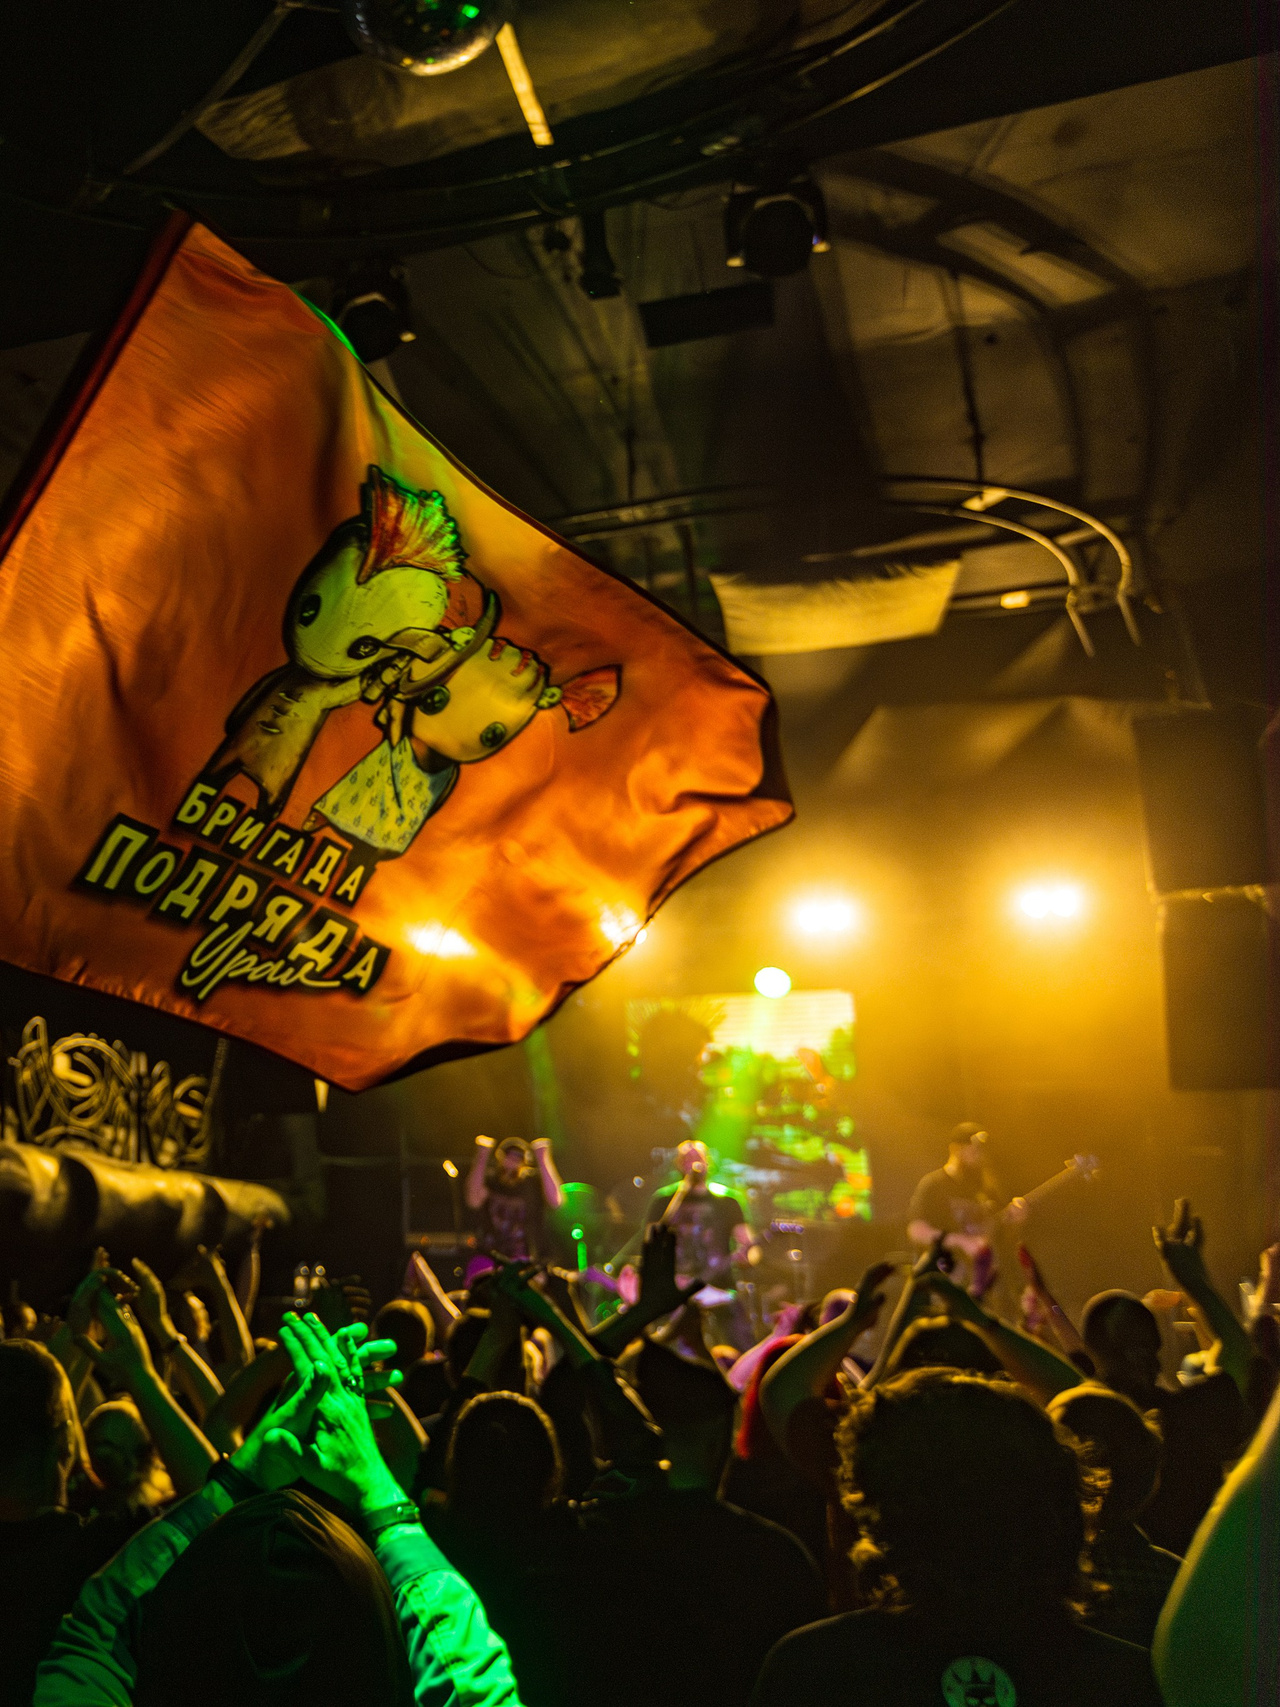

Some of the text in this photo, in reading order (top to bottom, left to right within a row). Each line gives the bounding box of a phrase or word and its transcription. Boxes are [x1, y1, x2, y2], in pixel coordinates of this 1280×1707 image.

[176, 783, 365, 902] БРИГАДА
[85, 823, 378, 989] ПОДРЯДА
[181, 920, 341, 1000] Урал
